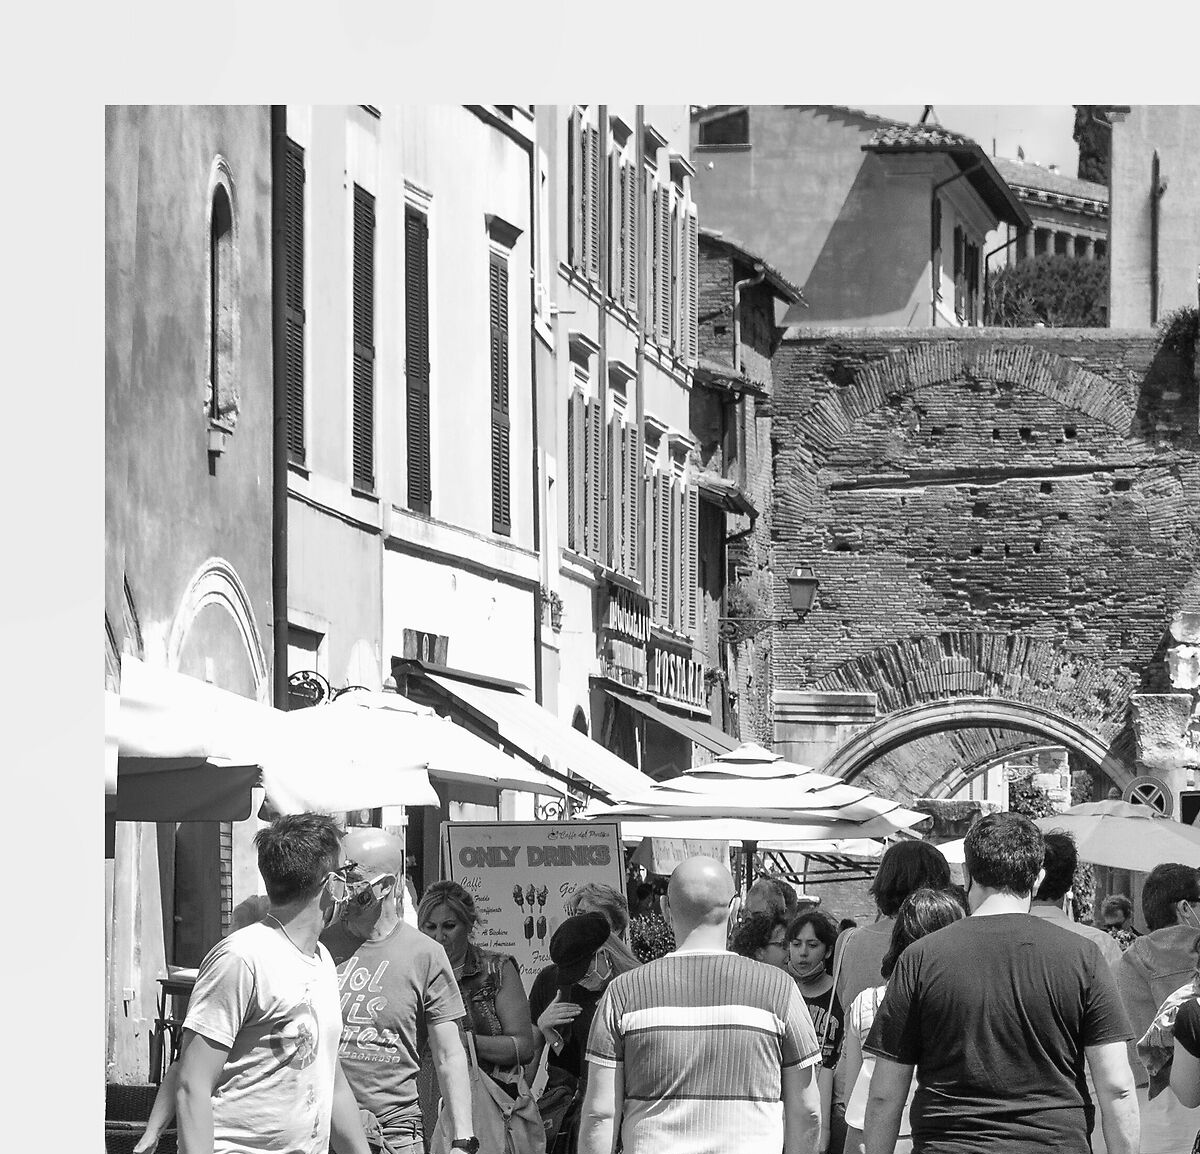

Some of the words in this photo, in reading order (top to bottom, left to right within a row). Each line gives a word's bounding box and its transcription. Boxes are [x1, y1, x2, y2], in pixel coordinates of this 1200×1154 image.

[655, 648, 706, 708] HOSTARIA
[459, 846, 521, 867] ONLY
[527, 845, 611, 867] DRINKS
